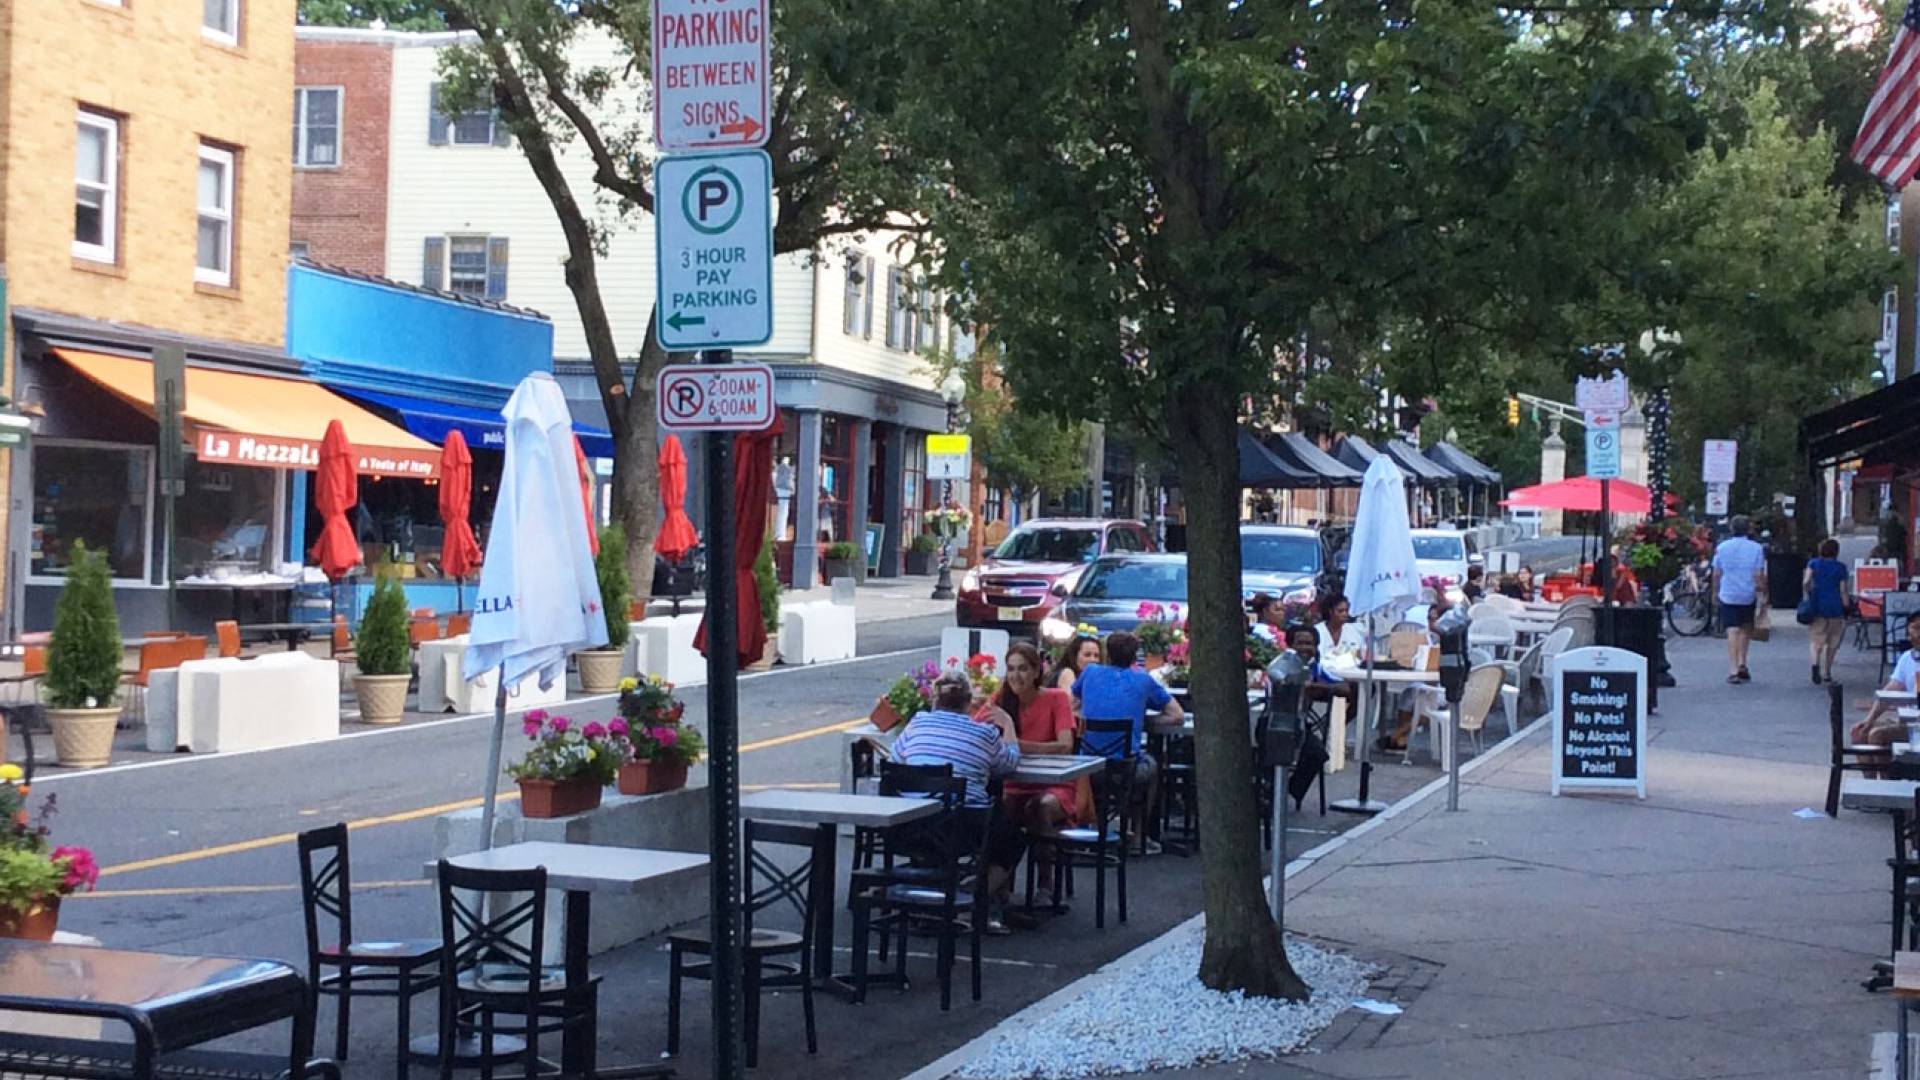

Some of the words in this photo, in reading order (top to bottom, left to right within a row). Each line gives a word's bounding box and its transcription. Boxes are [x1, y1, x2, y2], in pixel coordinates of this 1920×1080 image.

[662, 8, 758, 48] PARKING
[667, 61, 756, 89] BETWEEN
[683, 101, 740, 126] SIGNS
[699, 180, 729, 221] P
[681, 250, 691, 269] 3
[696, 247, 746, 265] HOUR
[696, 269, 732, 286] PAY
[673, 289, 757, 309] PARKING
[708, 398, 757, 416] 6:00AM
[204, 433, 230, 458] La
[239, 438, 319, 466] MezzaLu
[397, 459, 409, 472] of
[410, 460, 433, 475] Italy
[1590, 675, 1608, 689] No
[1571, 692, 1628, 708] Smoking!
[1574, 712, 1591, 724] No
[1594, 712, 1625, 725] Pets!
[1568, 730, 1585, 741] No
[1588, 730, 1630, 741] Alcohol
[1566, 744, 1606, 758] Beyond
[1609, 744, 1633, 757] This
[1582, 761, 1616, 774] Point!
